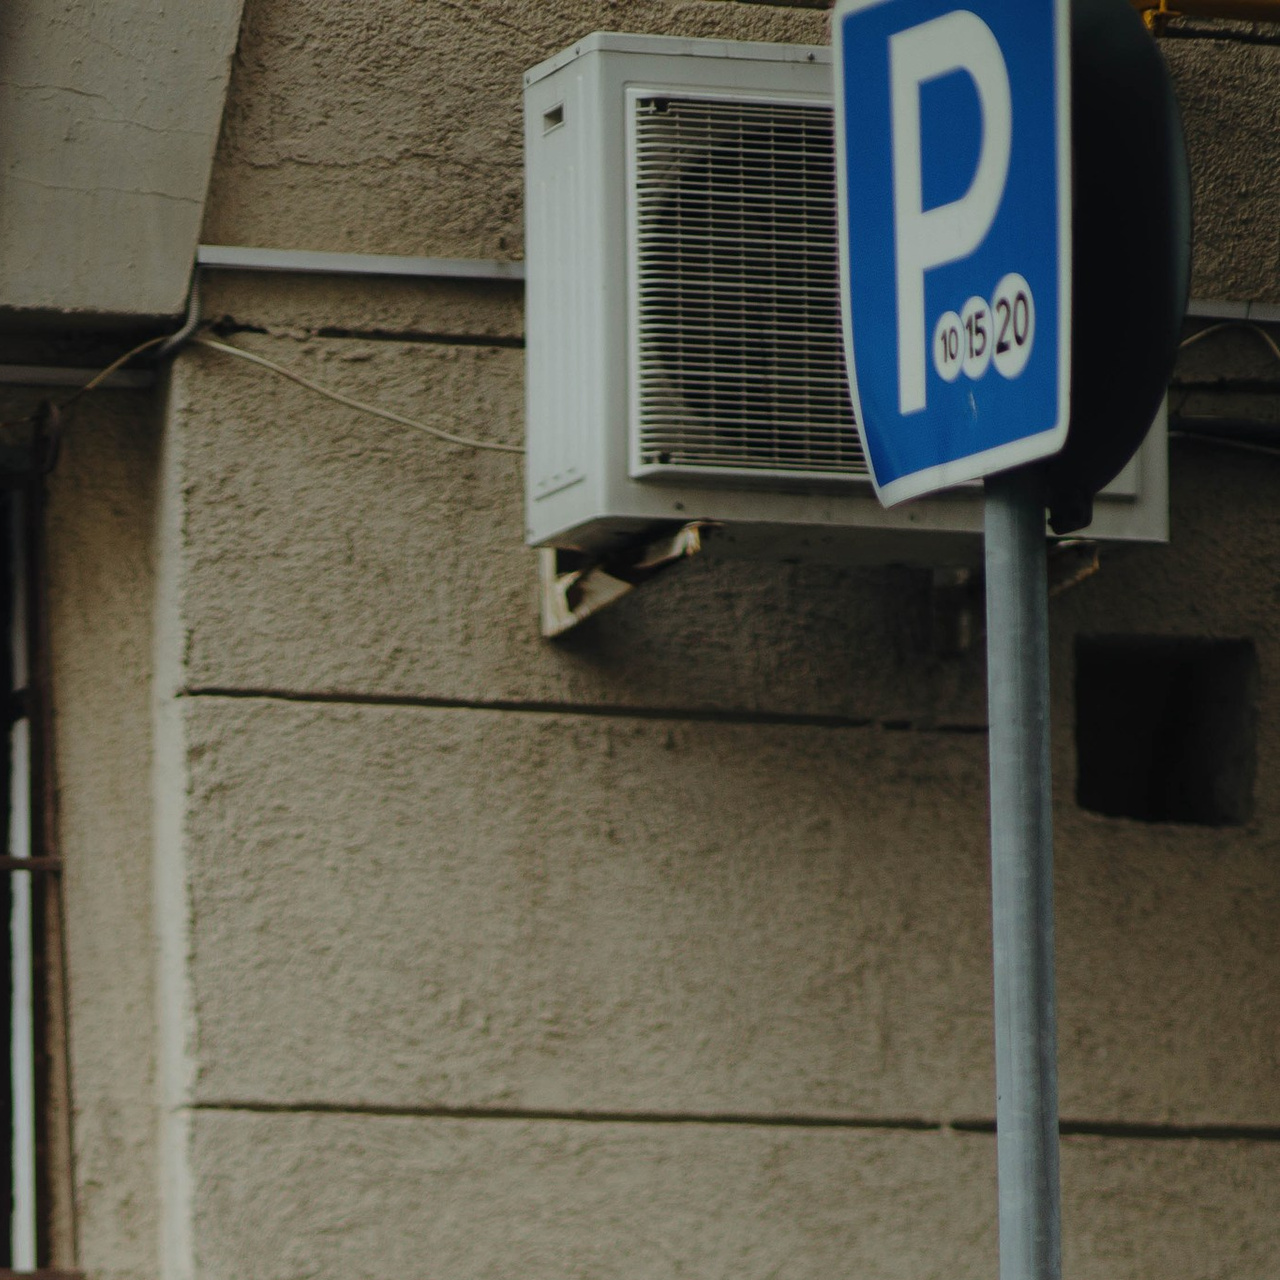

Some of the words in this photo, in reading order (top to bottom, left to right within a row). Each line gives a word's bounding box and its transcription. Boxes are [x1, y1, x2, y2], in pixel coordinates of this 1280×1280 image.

[888, 9, 1012, 415] P
[940, 327, 959, 363] 10
[965, 311, 987, 358] 15
[996, 292, 1029, 354] 20
